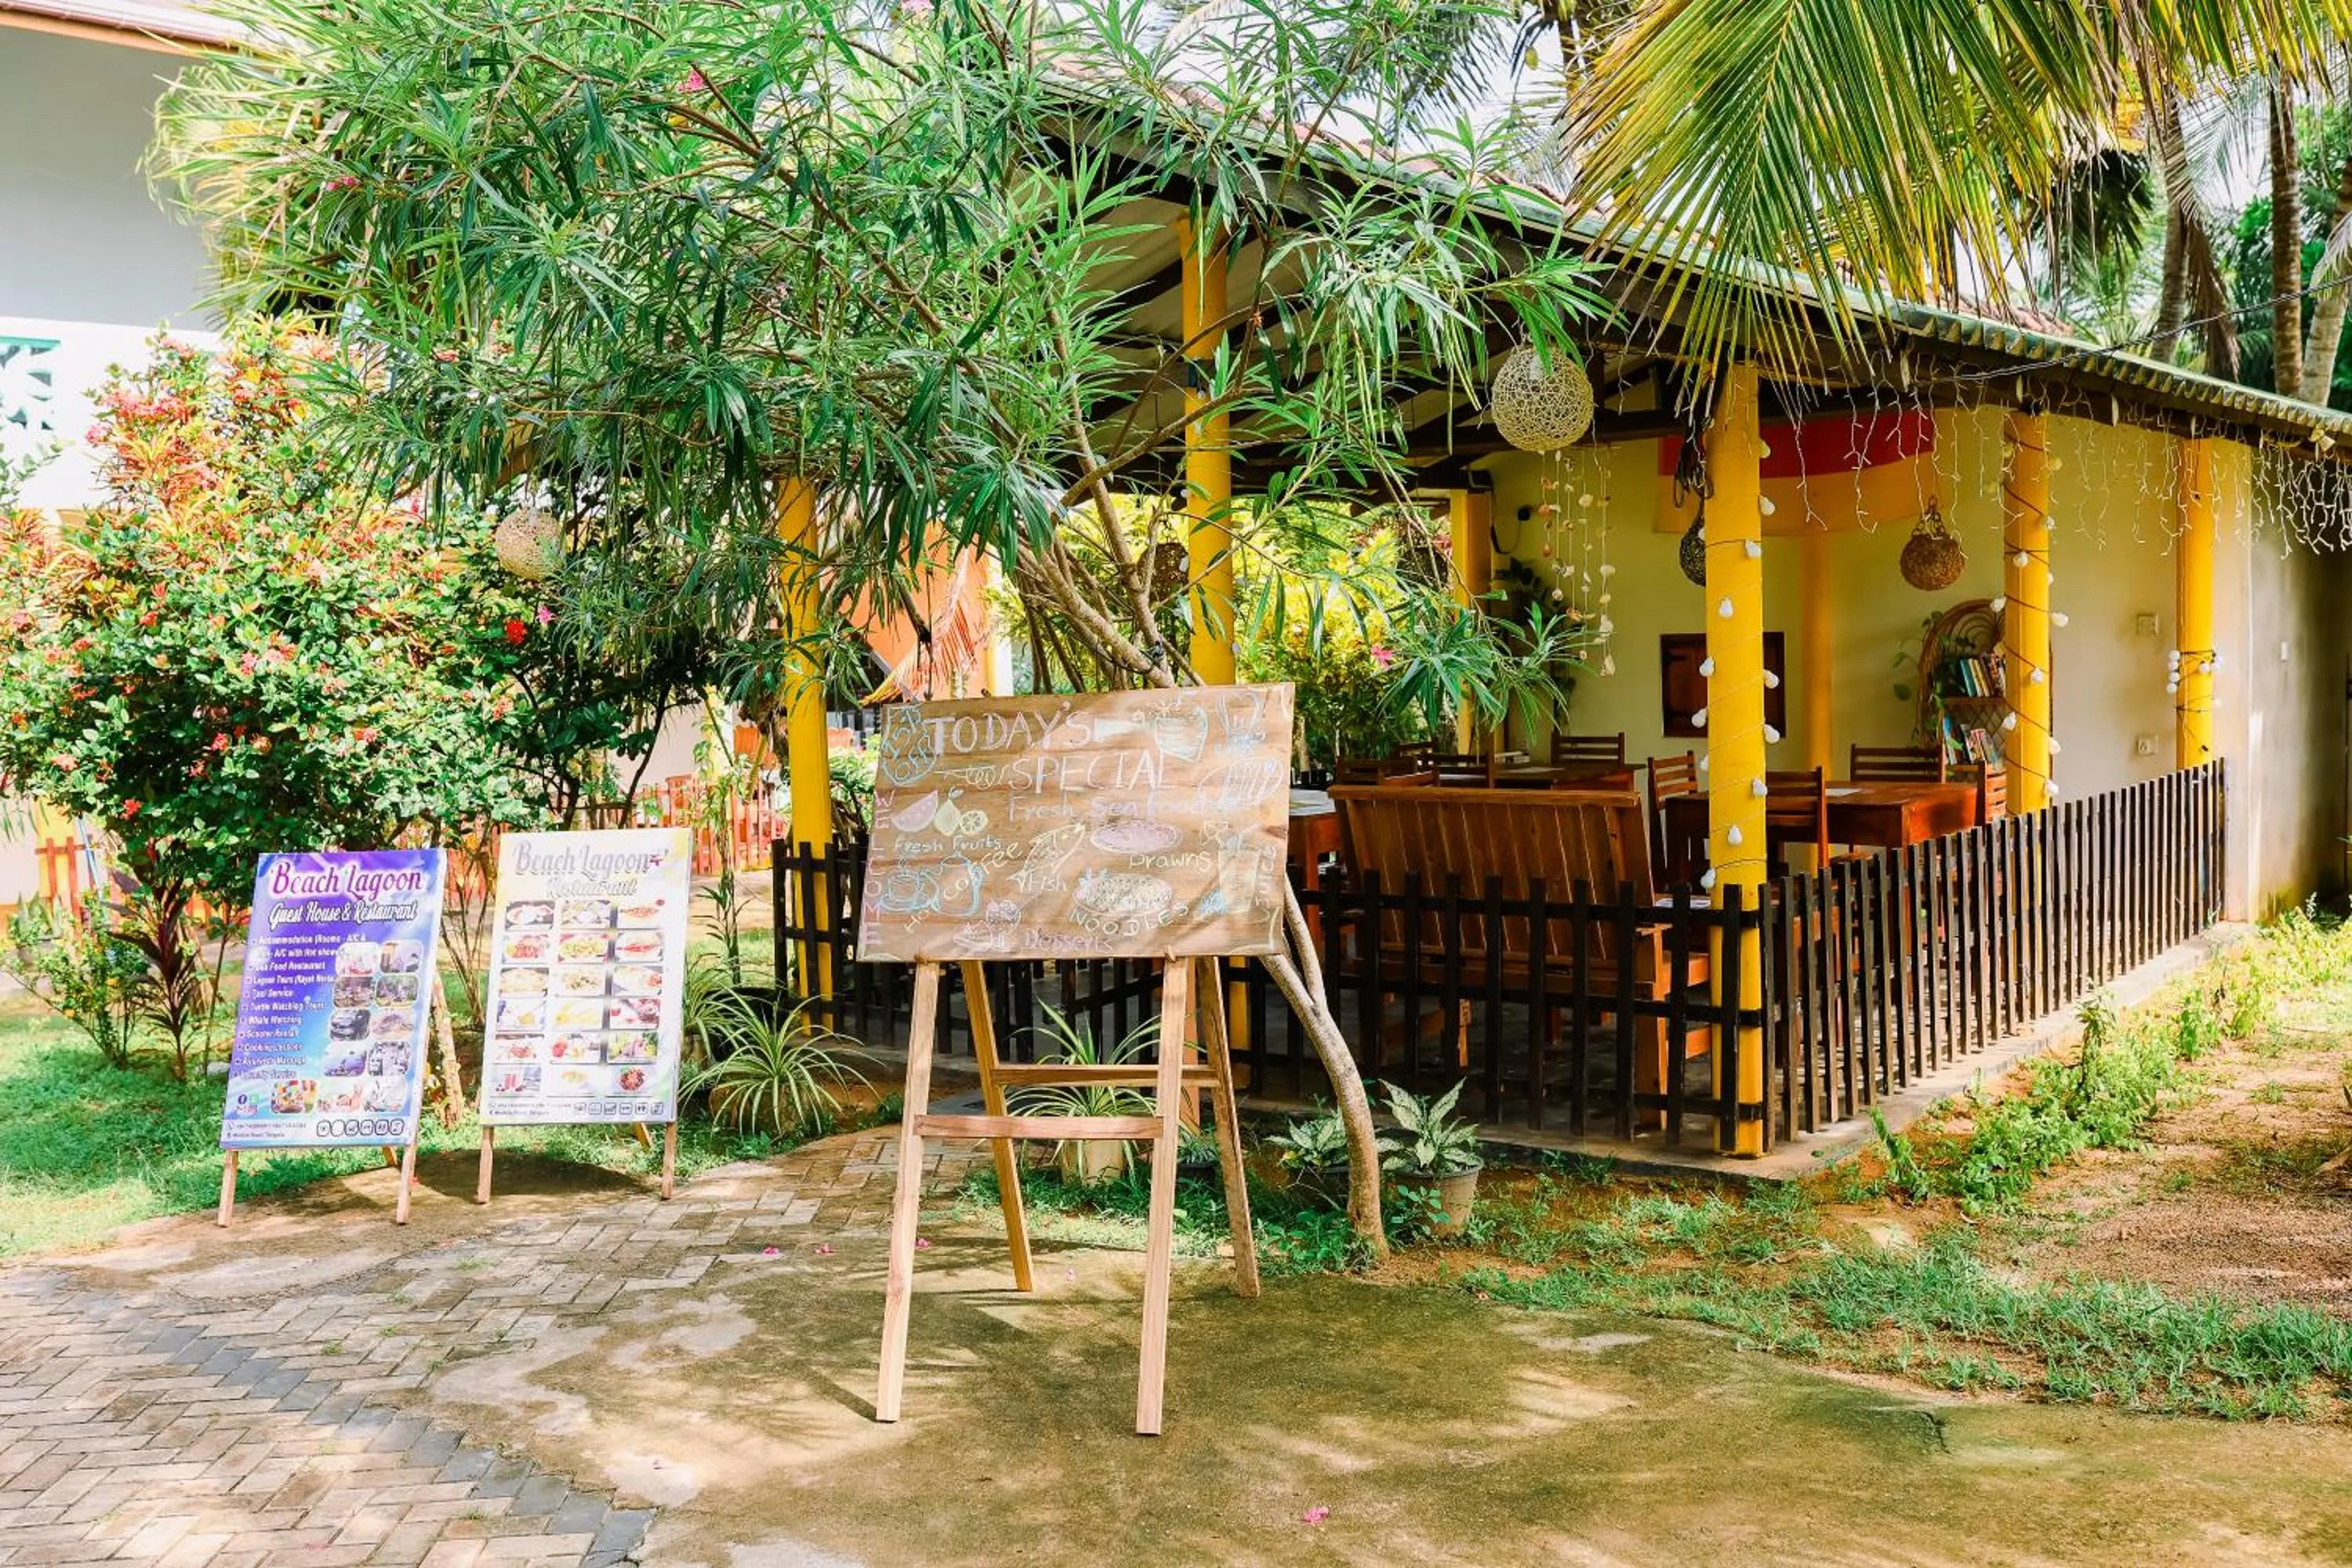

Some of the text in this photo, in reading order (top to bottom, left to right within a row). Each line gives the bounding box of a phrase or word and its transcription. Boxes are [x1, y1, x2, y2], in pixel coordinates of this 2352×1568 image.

[922, 702, 1092, 756] TODAY'S
[1009, 748, 1179, 794] SPECIAL
[514, 840, 651, 880] Beach Lagoon
[863, 789, 895, 946] WELCOME
[272, 862, 423, 900] Beach Lagoon
[1028, 873, 1068, 893] Fish
[268, 901, 419, 931] Guest House & Restaurant
[1069, 902, 1189, 936] NOODLES
